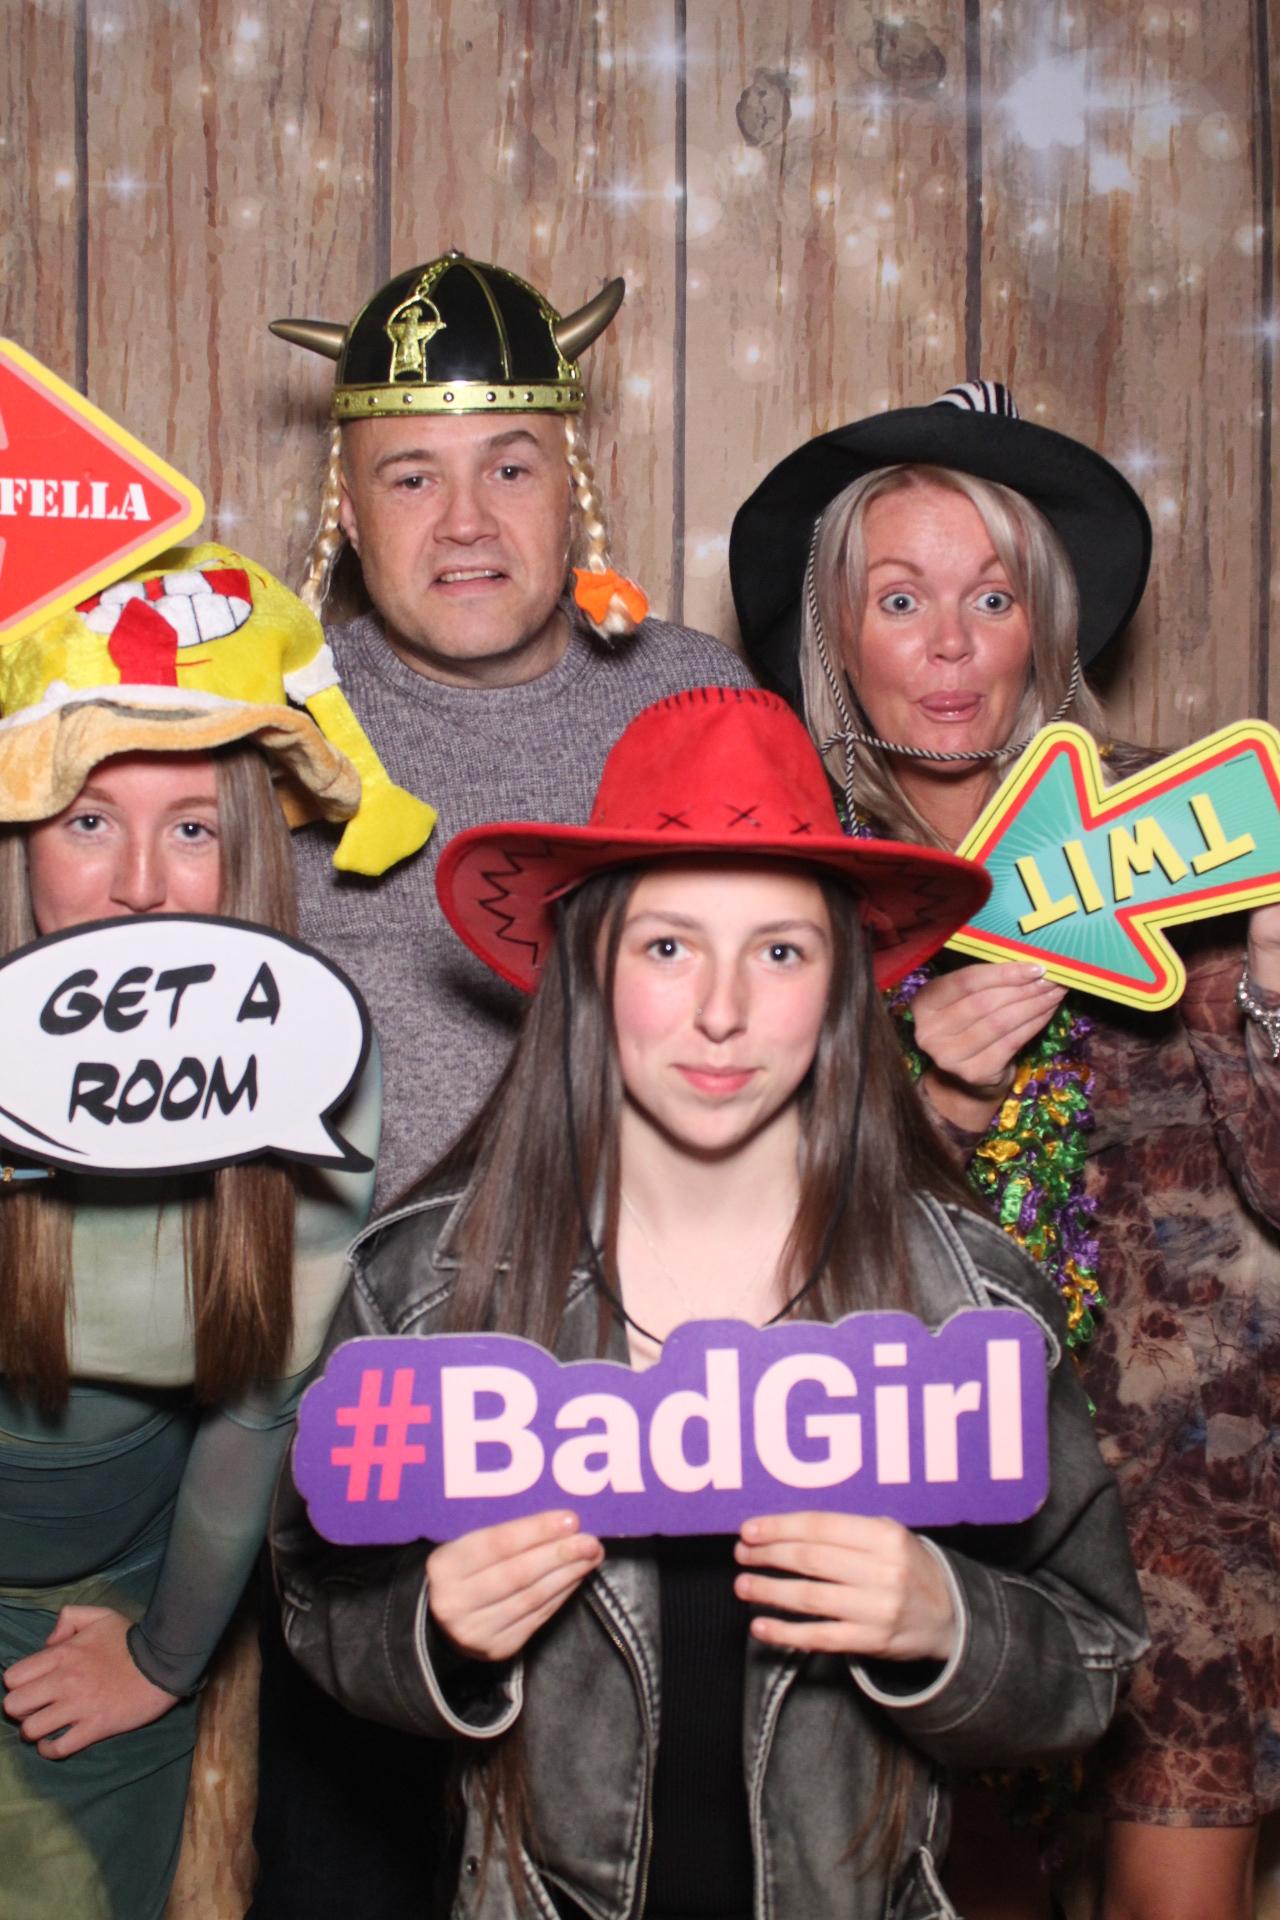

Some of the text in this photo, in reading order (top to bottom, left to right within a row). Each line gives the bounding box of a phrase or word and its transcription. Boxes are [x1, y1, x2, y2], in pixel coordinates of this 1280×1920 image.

[1014, 793, 1257, 935] TWIT
[39, 961, 281, 1036] GET A
[68, 1053, 258, 1126] ROOM
[330, 1338, 1024, 1502] #BadGirl
